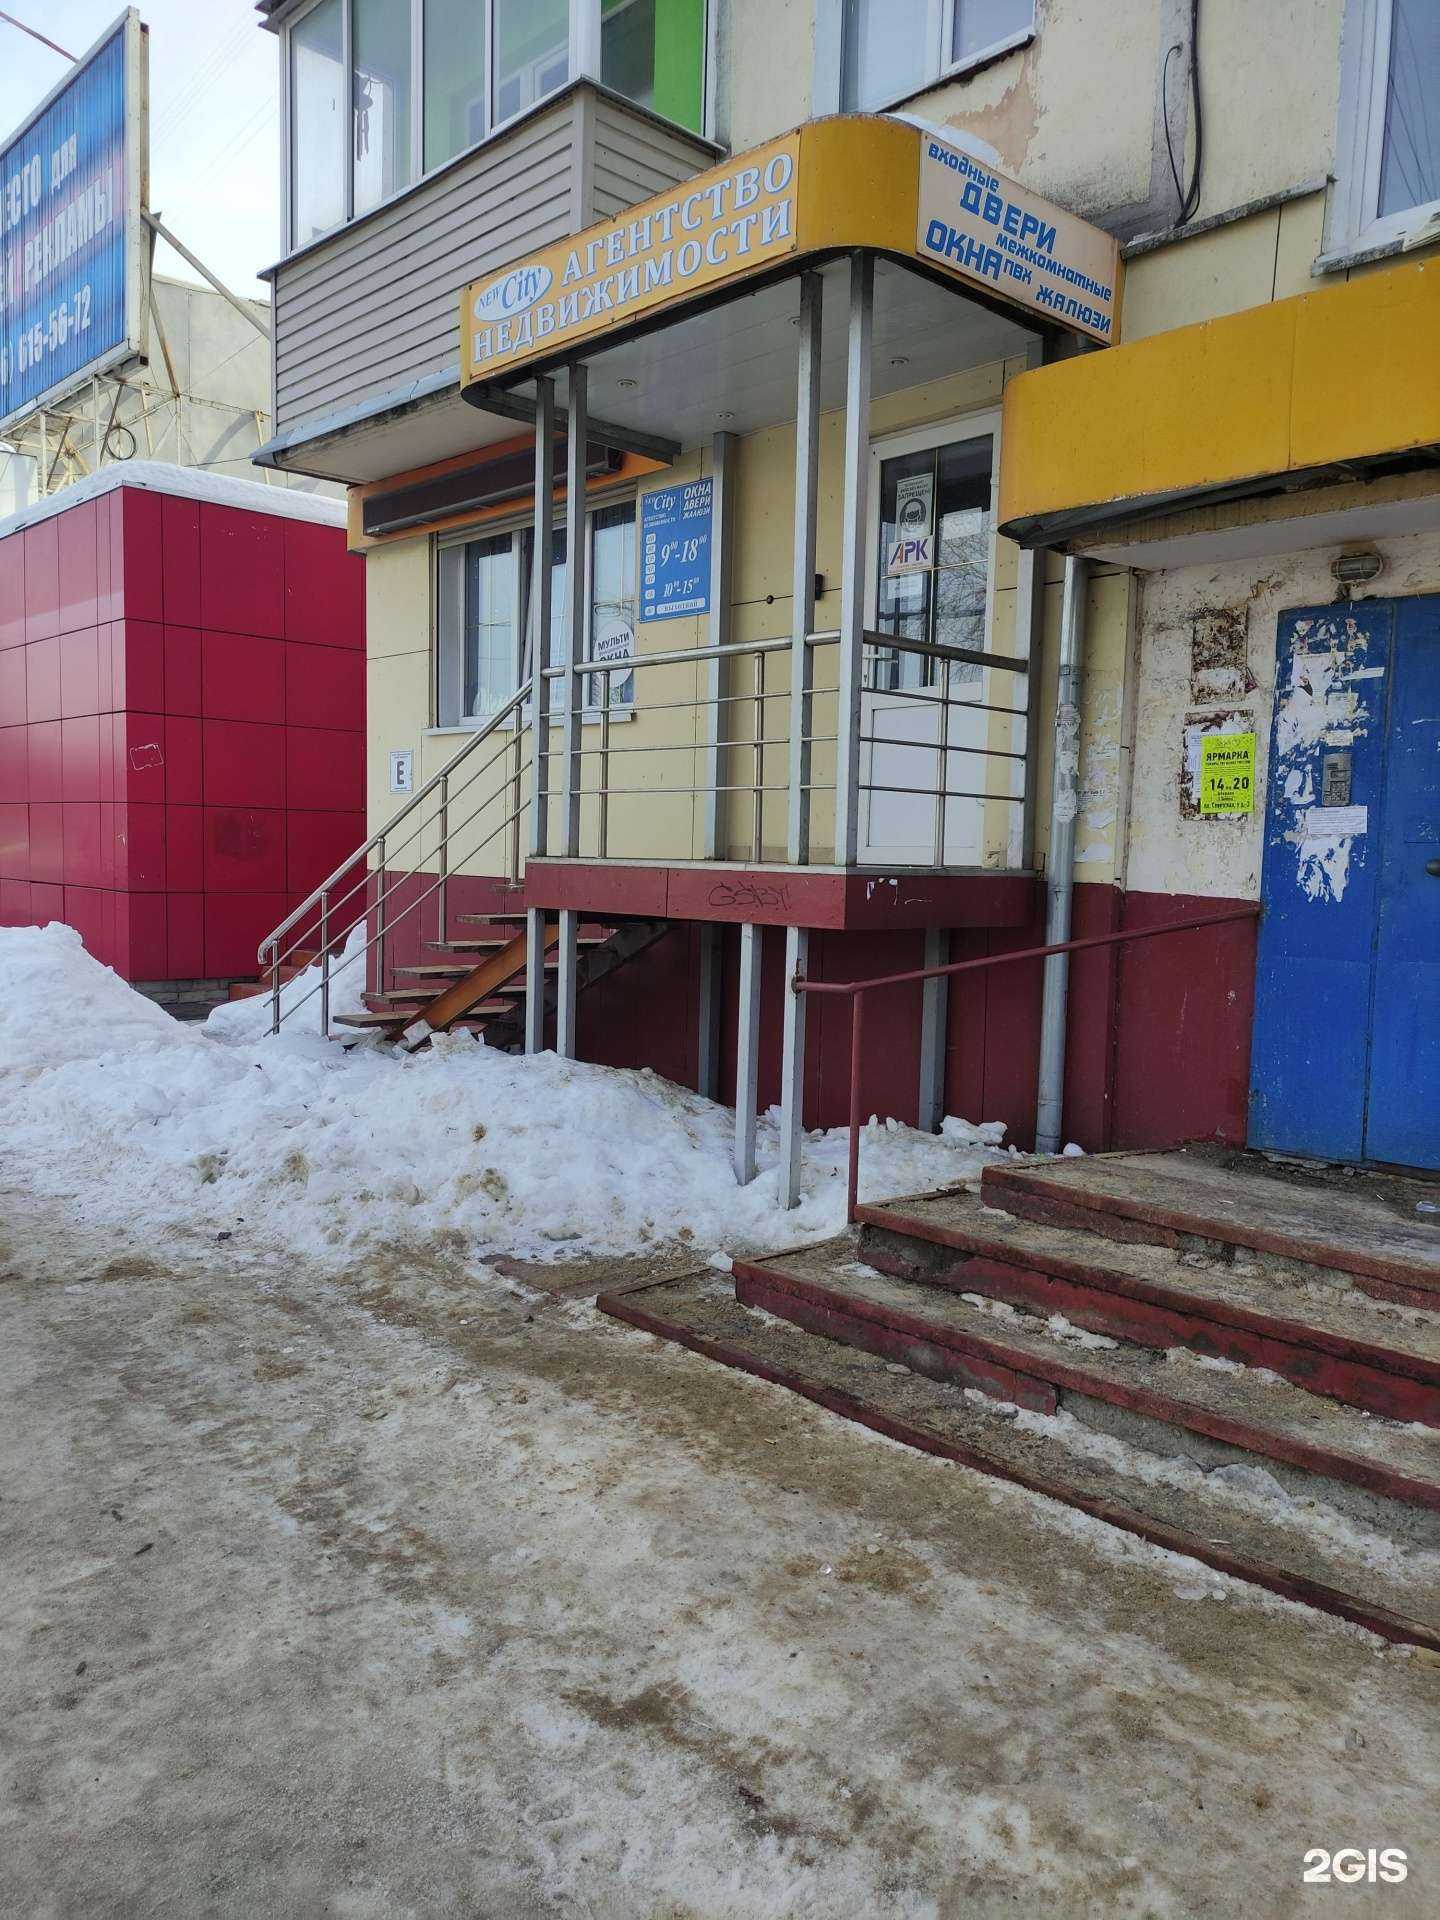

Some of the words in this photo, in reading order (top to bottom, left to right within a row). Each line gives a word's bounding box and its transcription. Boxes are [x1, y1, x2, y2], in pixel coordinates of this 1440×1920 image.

[928, 142, 999, 193] входные
[0, 154, 41, 238] ЕСТО
[560, 152, 794, 288] АГЕНТСТВО
[959, 181, 1057, 254] ДВЕРИ
[24, 168, 113, 292] РЕКЛАМЫ
[472, 200, 792, 364] НЕДВИЖИМОСТИ
[480, 286, 500, 309] NEW
[502, 267, 542, 309] City
[925, 219, 1003, 281] ОКНА
[1036, 284, 1112, 334] ЖАЛЮЗИ
[996, 233, 1112, 302] межкомнатные
[654, 494, 676, 511] City
[683, 495, 711, 512] ДВЕРИ
[684, 481, 711, 500] ОКНА
[598, 631, 630, 651] МУЛЬТИ
[1206, 750, 1249, 762] ЯРМАРКА
[1210, 777, 1225, 791] 14
[1233, 776, 1250, 790] 20
